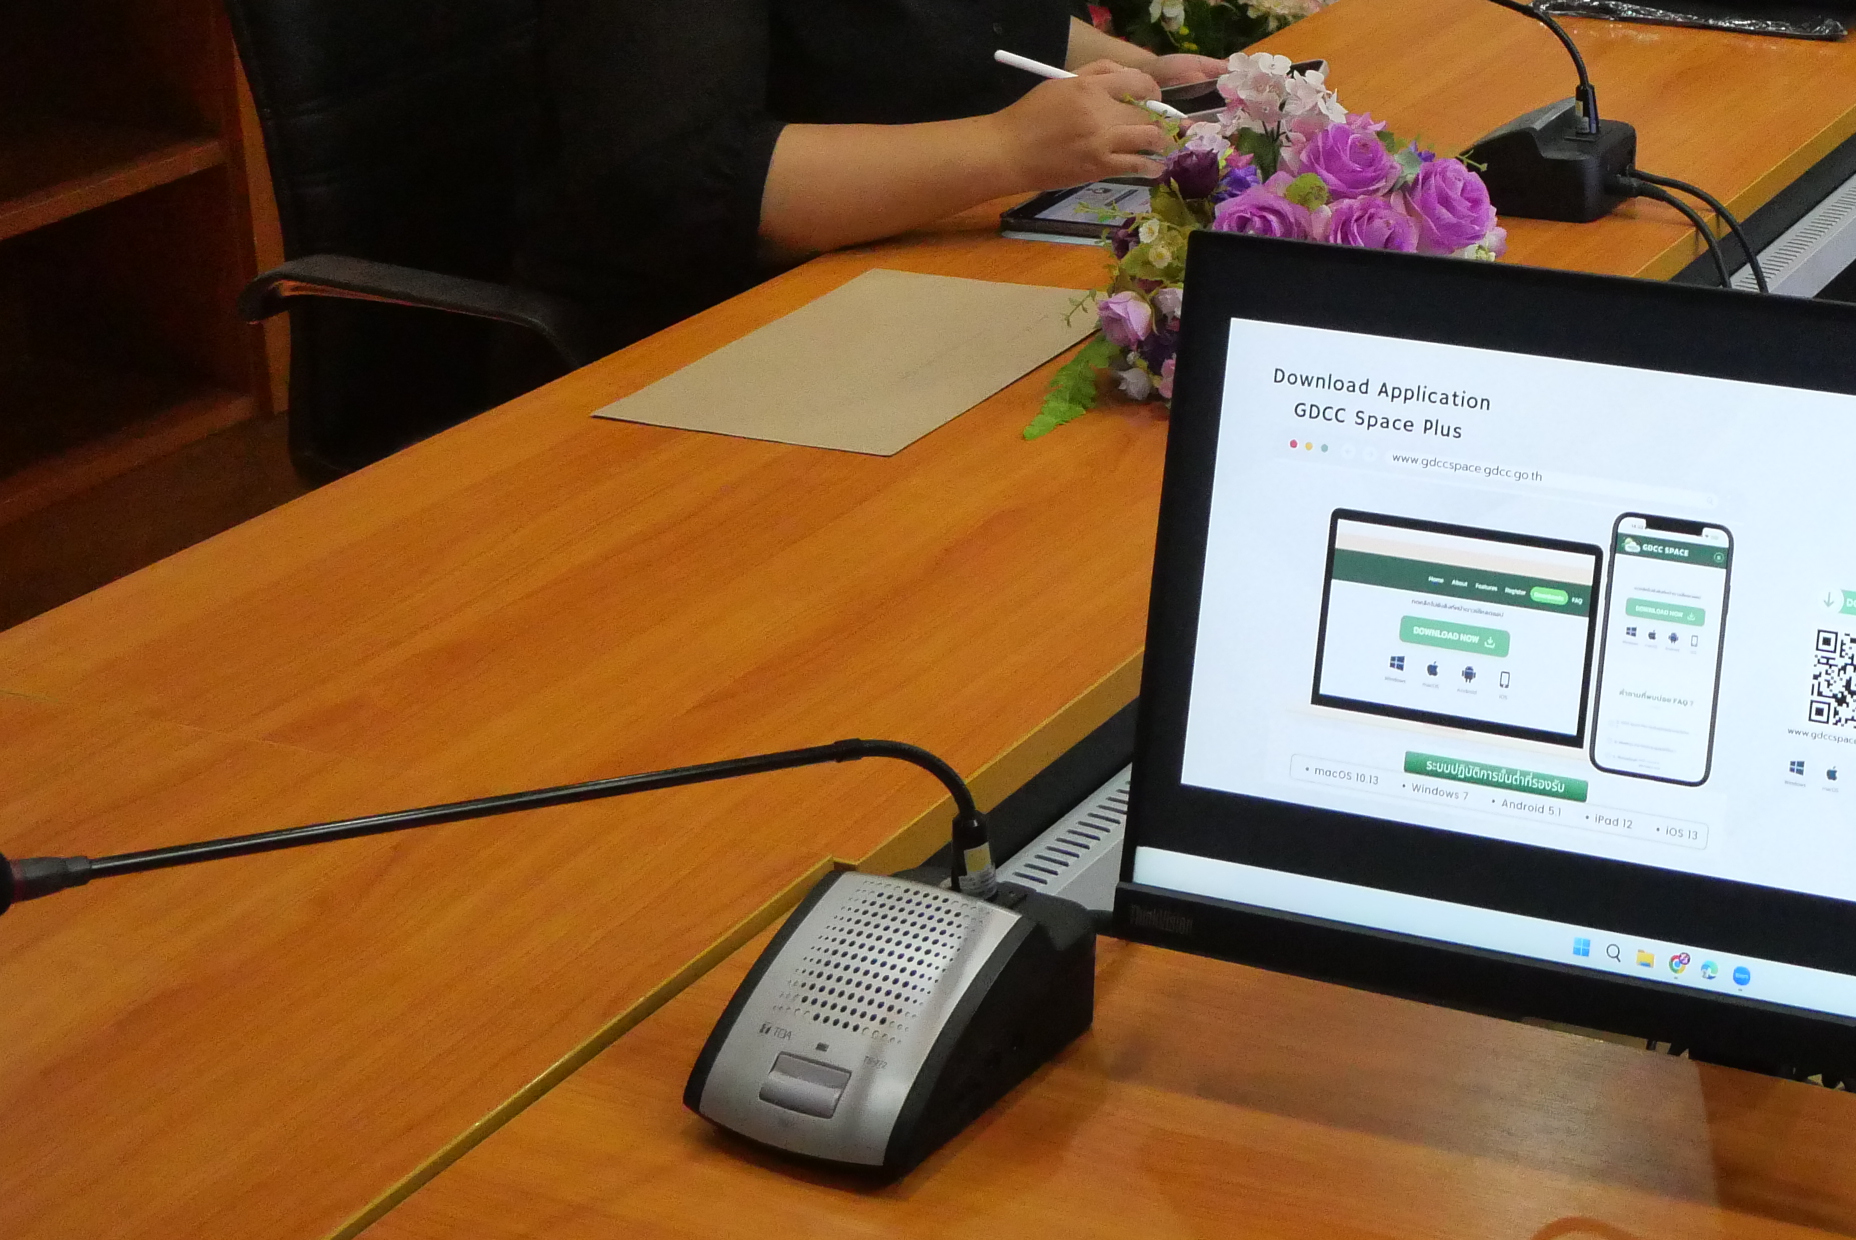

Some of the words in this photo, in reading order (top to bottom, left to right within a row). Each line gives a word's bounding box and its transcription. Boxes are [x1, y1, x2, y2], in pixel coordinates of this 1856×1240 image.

[1273, 368, 1370, 395] Download
[1377, 382, 1491, 411] Application
[1294, 402, 1346, 423] GDCC
[1354, 410, 1414, 432] Space
[1423, 418, 1462, 439] Plus
[1392, 453, 1543, 482] www.gdccspace.gdcc.go.th
[1642, 543, 1663, 553] GDCC
[1664, 546, 1689, 557] SPACE
[1428, 575, 1444, 584] Home
[1451, 579, 1468, 587] About
[1475, 582, 1498, 592] Features
[1505, 587, 1526, 596] Register
[1571, 597, 1583, 605] FAQ
[1413, 626, 1459, 641] DOWNLOAD
[1460, 634, 1480, 644] NOW
[1673, 698, 1688, 707] FAQ
[1314, 766, 1352, 781] macOS
[1356, 772, 1379, 785] 10.13
[1411, 782, 1460, 800] Windows
[1463, 791, 1469, 801] 7
[1501, 798, 1545, 814] Android
[1549, 806, 1562, 817] 5.1
[1594, 814, 1619, 828] iPad
[1622, 819, 1633, 830] 12
[1665, 826, 1684, 838] iOS
[1687, 830, 1698, 841] 13
[773, 1026, 792, 1040] TOA
